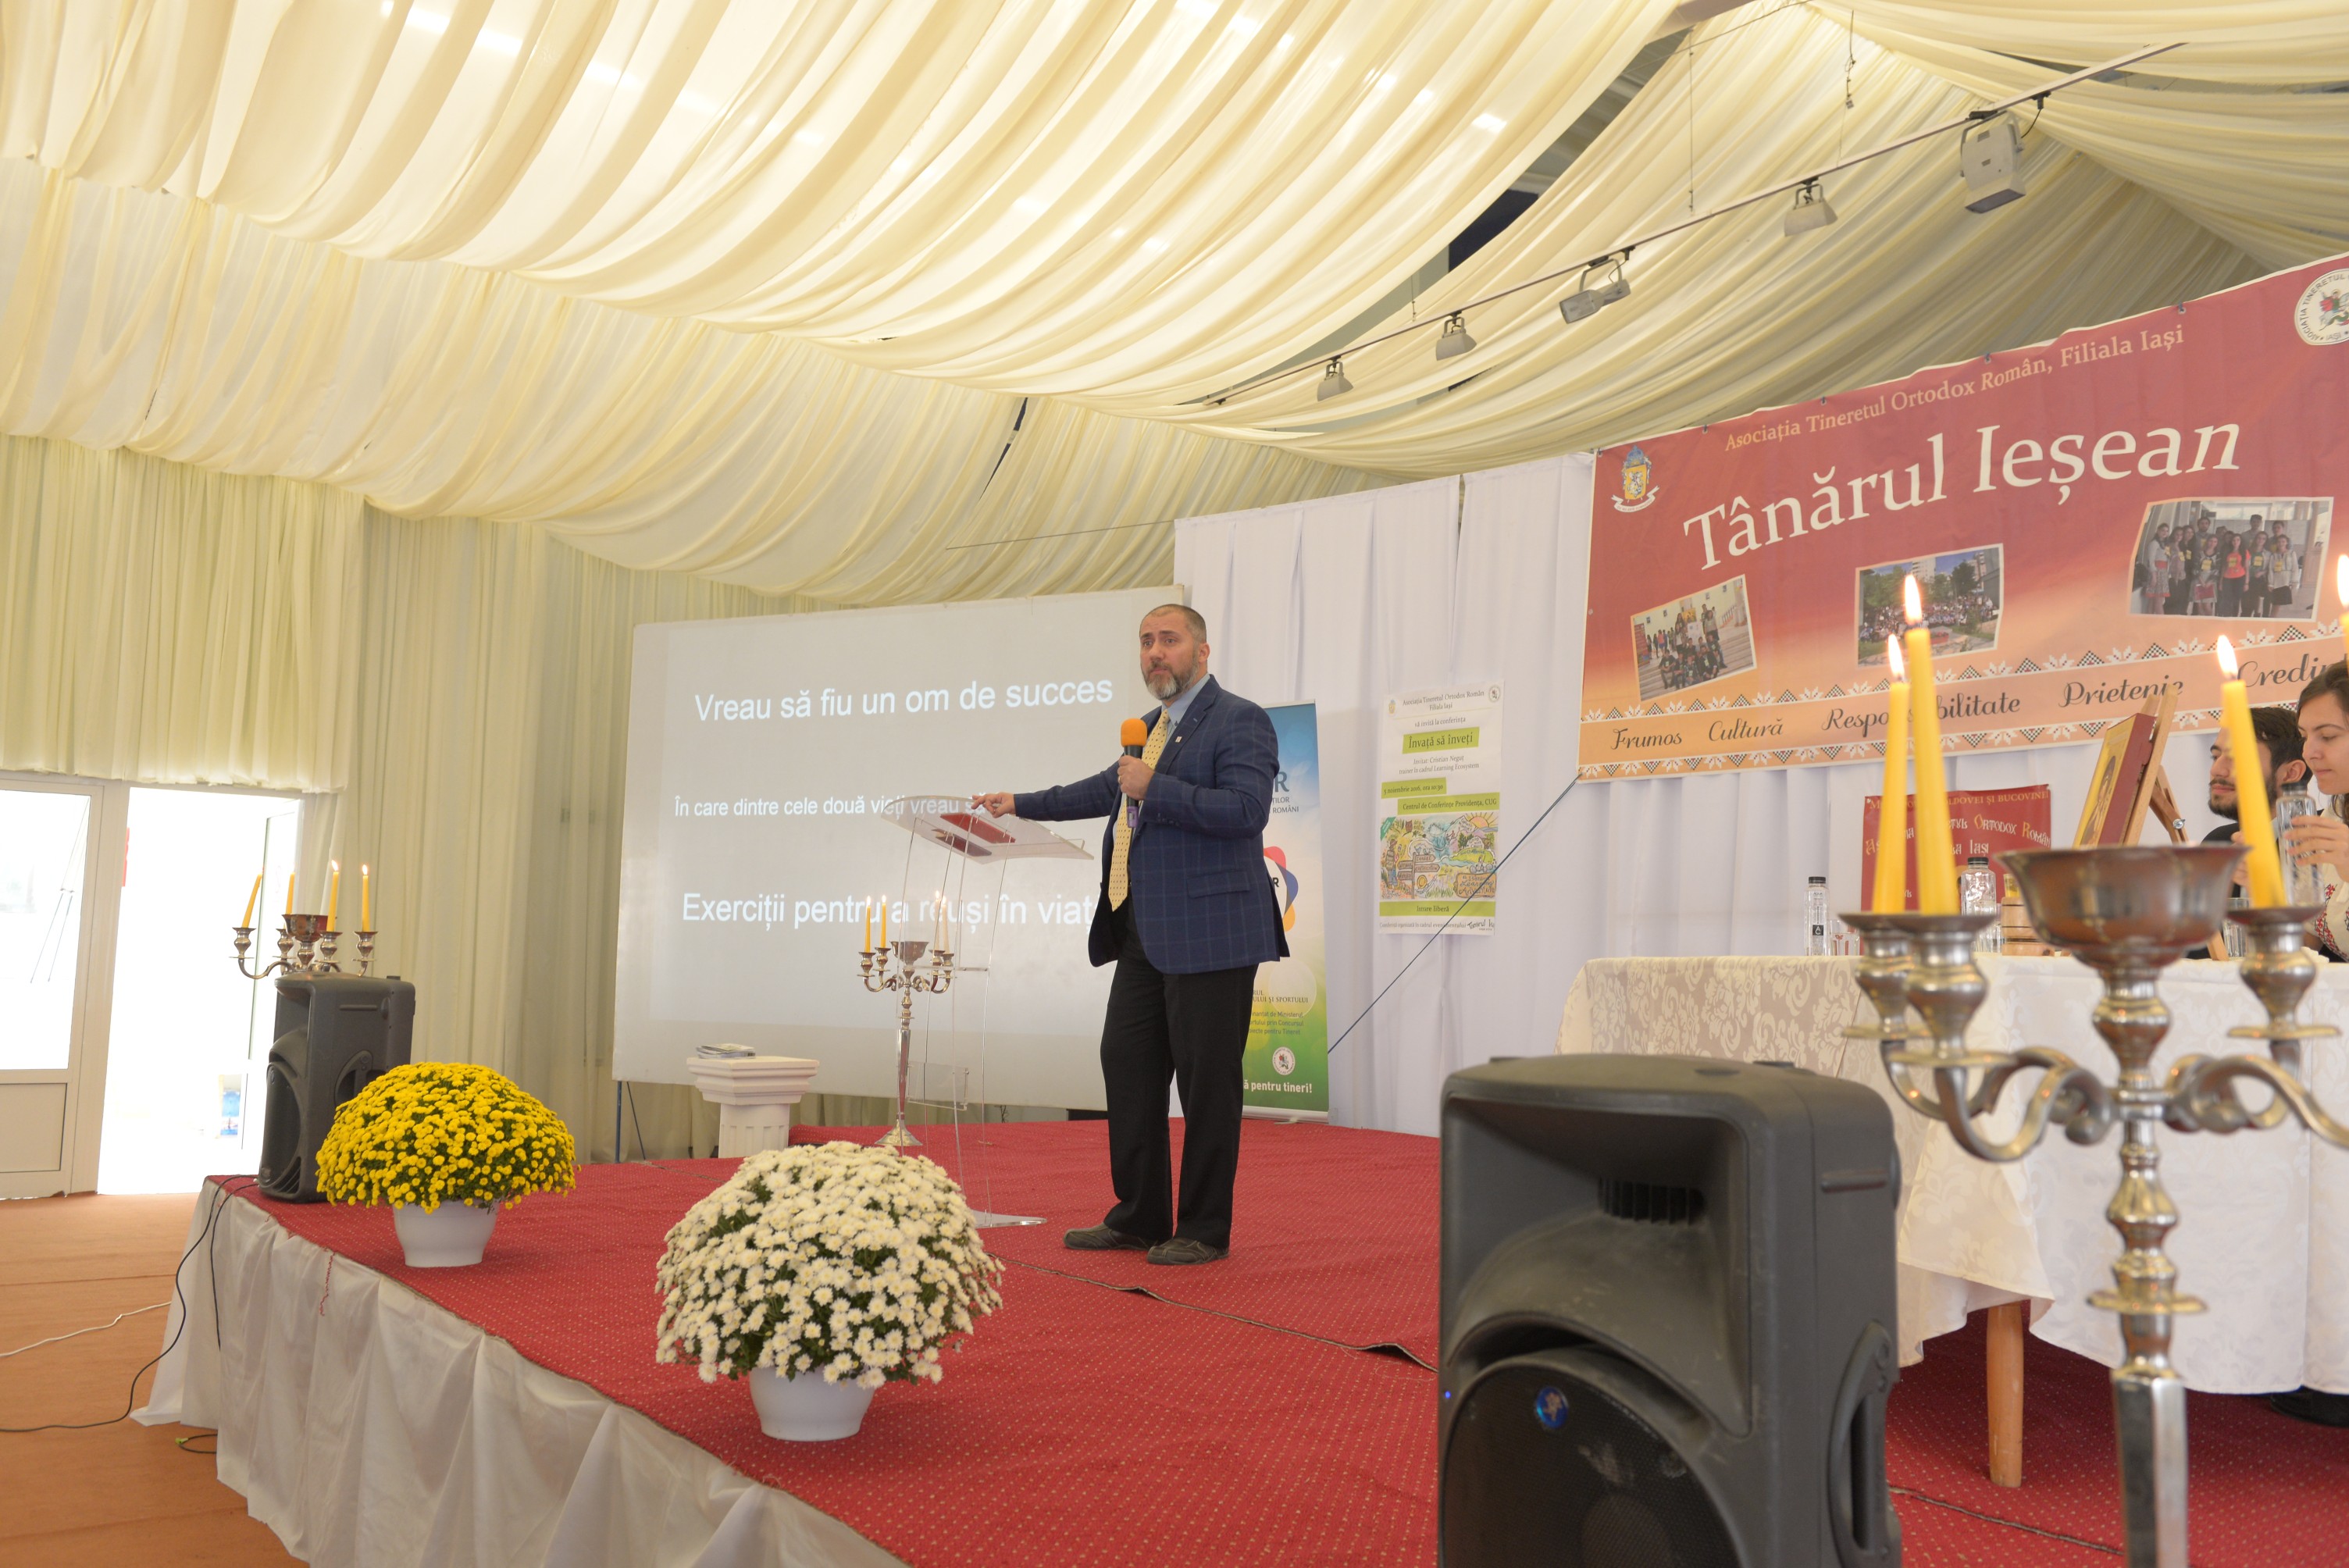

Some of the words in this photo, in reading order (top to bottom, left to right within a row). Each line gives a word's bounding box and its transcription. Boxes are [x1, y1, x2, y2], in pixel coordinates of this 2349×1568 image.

[1805, 395, 1886, 433] Tineretul
[1891, 379, 1976, 411] Ortodox
[1980, 358, 2053, 390] Român,
[2060, 336, 2133, 368] Filiala
[2140, 324, 2184, 352] Iași
[1682, 433, 1948, 571] Tânărul
[1973, 422, 2240, 506] Ieșean
[694, 693, 772, 722] Vreau
[780, 690, 811, 718] să
[820, 687, 852, 718] fiu
[861, 692, 896, 715] un
[904, 689, 950, 713] om
[959, 681, 996, 711] de
[1004, 678, 1114, 708] succes
[1445, 692, 1466, 700] Ortodox
[1610, 728, 1682, 750] Frumos
[1709, 718, 1784, 743] Cultură
[1821, 692, 2021, 738] Resposbilitate
[1436, 736, 1445, 746] să
[674, 795, 689, 817] În
[693, 800, 729, 817] care
[733, 797, 779, 816] dintre
[783, 796, 818, 815] cele
[822, 795, 865, 814] două
[910, 798, 959, 814] vreau
[1403, 802, 1420, 811] Centrul
[1946, 796, 1984, 805] LDOVEI
[1998, 790, 2048, 803] BUCOVINEI
[1272, 805, 1299, 814] ROMÂNI
[683, 893, 785, 932] Exerciții
[793, 894, 881, 929] pentru
[890, 900, 909, 924] a
[999, 894, 1027, 924] în
[1037, 894, 1099, 935] viaț
[1251, 1081, 1281, 1092] pentru
[1283, 1082, 1313, 1093] tineri!
